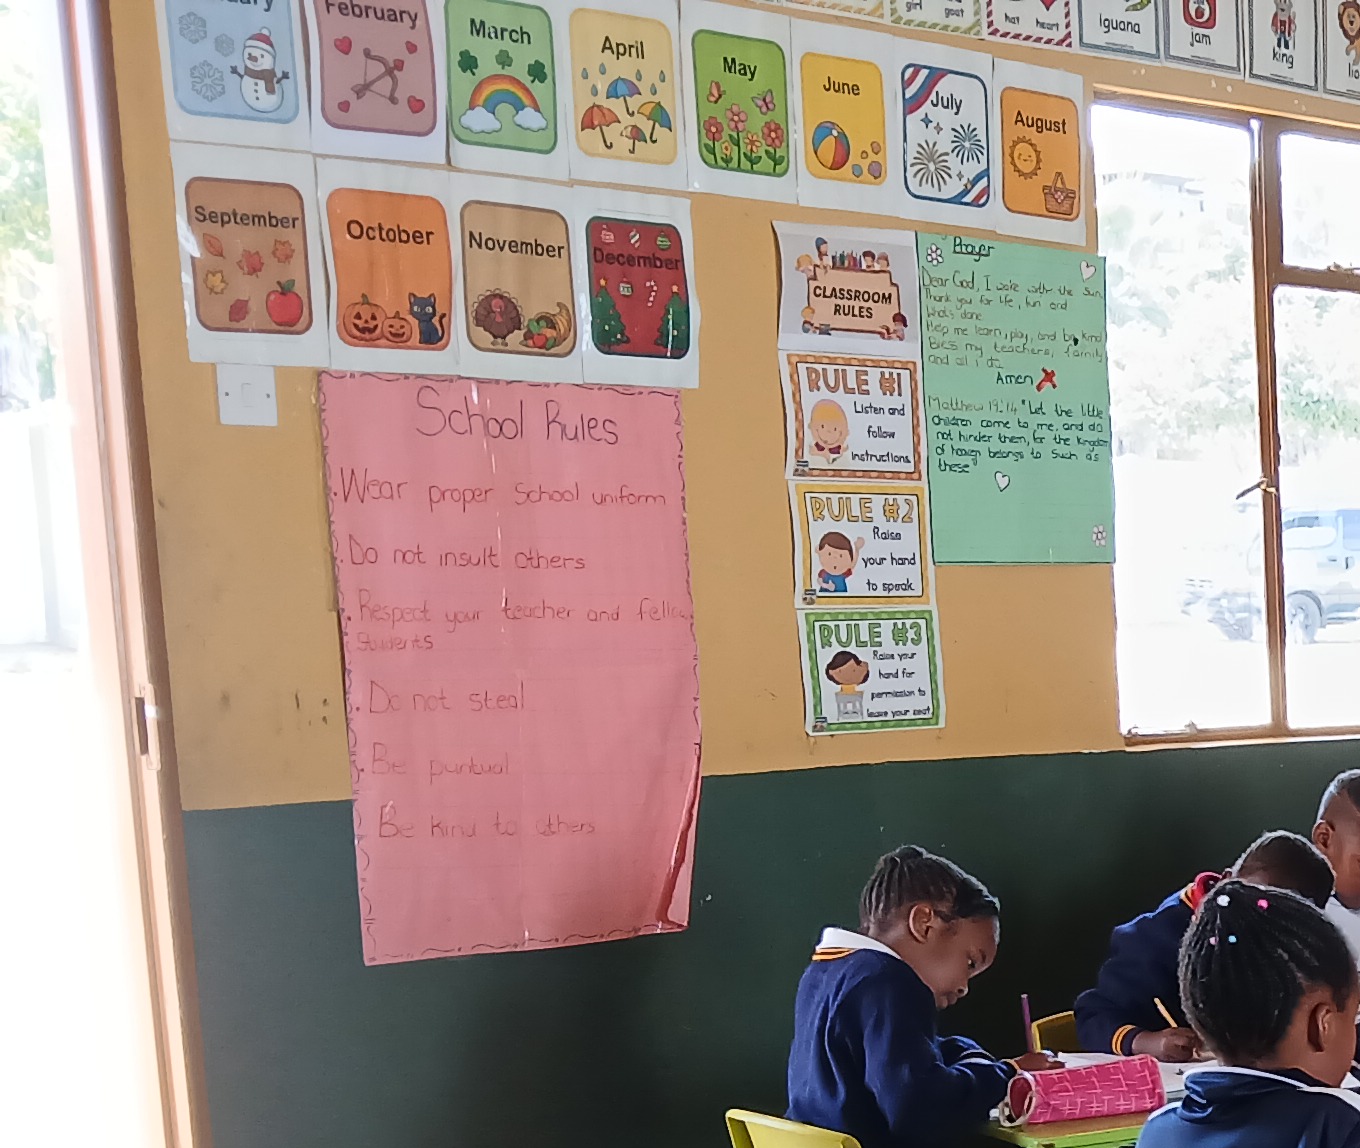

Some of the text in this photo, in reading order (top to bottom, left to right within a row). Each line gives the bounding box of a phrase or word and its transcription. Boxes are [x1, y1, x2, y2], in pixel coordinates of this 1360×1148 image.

[325, 0, 418, 30] February
[469, 19, 531, 46] March
[1190, 28, 1211, 47] jam
[601, 37, 645, 60] April
[1272, 49, 1294, 69] king
[722, 56, 757, 81] May
[823, 76, 860, 97] June
[931, 91, 963, 116] July
[1014, 110, 1068, 135] August
[195, 205, 299, 230] September
[346, 220, 435, 246] October
[468, 231, 565, 259] November
[593, 246, 681, 271] December
[812, 284, 893, 305] CLASSROOM
[833, 303, 874, 319] RULES
[806, 367, 903, 397] RULE #1
[995, 371, 1033, 386] Amen
[416, 385, 619, 445] School Rules
[428, 485, 666, 512] proper uniform
[810, 496, 914, 524] RULE #2
[872, 526, 902, 541] Raise
[439, 545, 499, 568] insult
[890, 552, 917, 567] hand
[818, 621, 923, 649] RULE #3
[468, 680, 525, 711] steal
